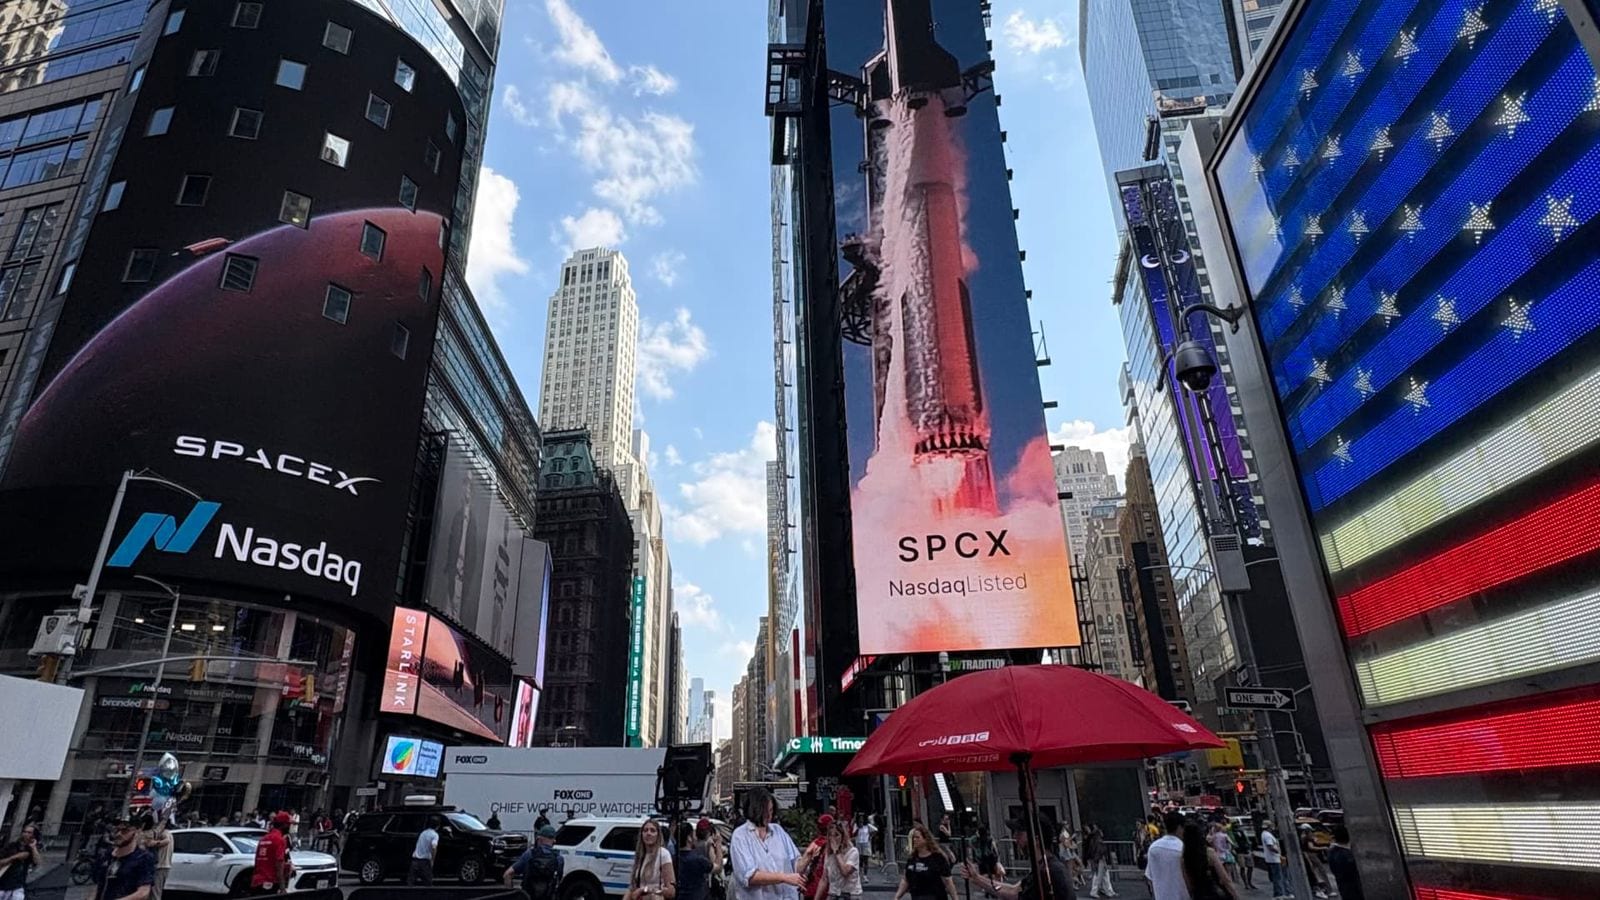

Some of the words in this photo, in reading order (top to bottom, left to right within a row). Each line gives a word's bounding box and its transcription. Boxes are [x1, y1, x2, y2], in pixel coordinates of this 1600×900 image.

[173, 435, 382, 495] SPACEX
[899, 529, 1011, 562] SPCX
[214, 523, 361, 596] Nasdaq
[394, 615, 416, 706] STARLINK
[1235, 694, 1255, 703] ONE
[1263, 694, 1283, 704] WAY
[165, 732, 203, 744] Nasdaq
[455, 756, 472, 764] FOX
[554, 790, 574, 800] FOX
[575, 791, 592, 799] ONE
[491, 803, 523, 813] CHIEF
[527, 803, 571, 814] WORLD
[574, 803, 597, 814] CUP
